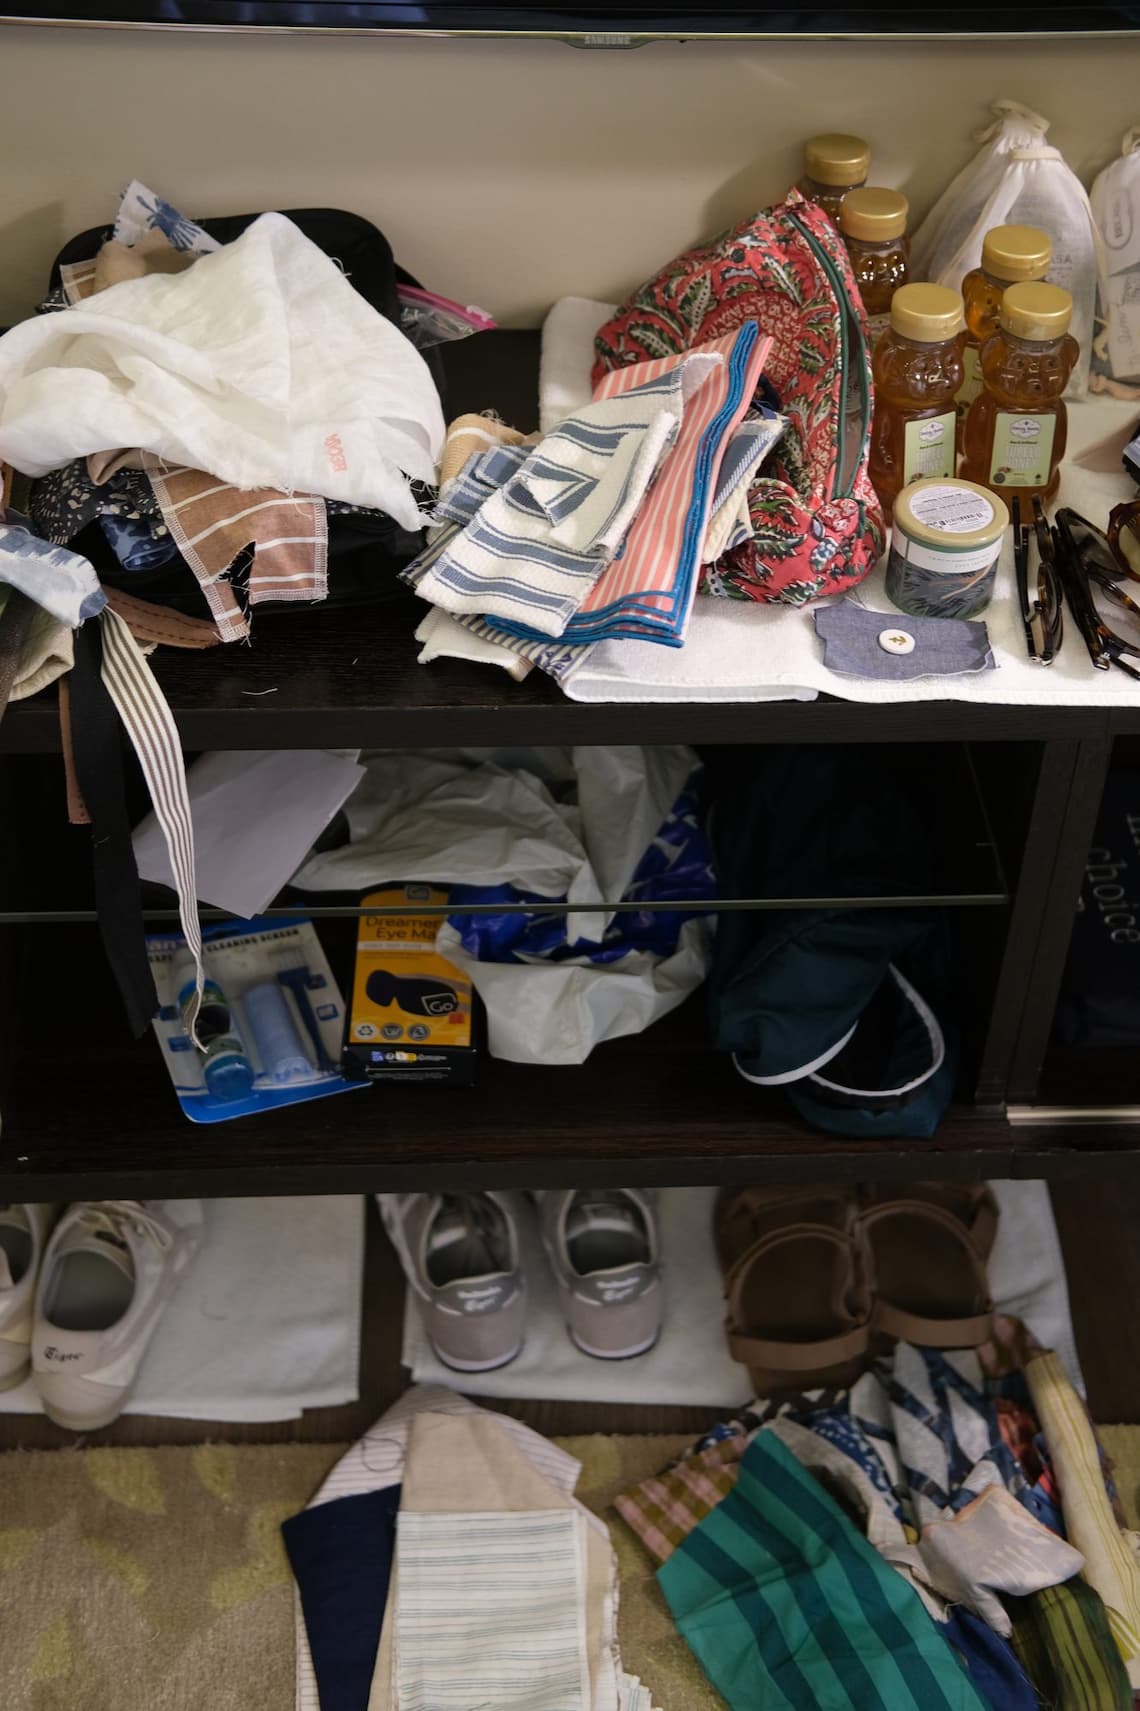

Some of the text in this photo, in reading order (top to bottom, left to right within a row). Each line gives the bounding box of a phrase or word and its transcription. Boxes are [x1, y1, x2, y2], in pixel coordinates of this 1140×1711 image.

[376, 928, 437, 940] Eye Ma
[429, 1000, 454, 1013] Go
[44, 1346, 80, 1362] Tiger
